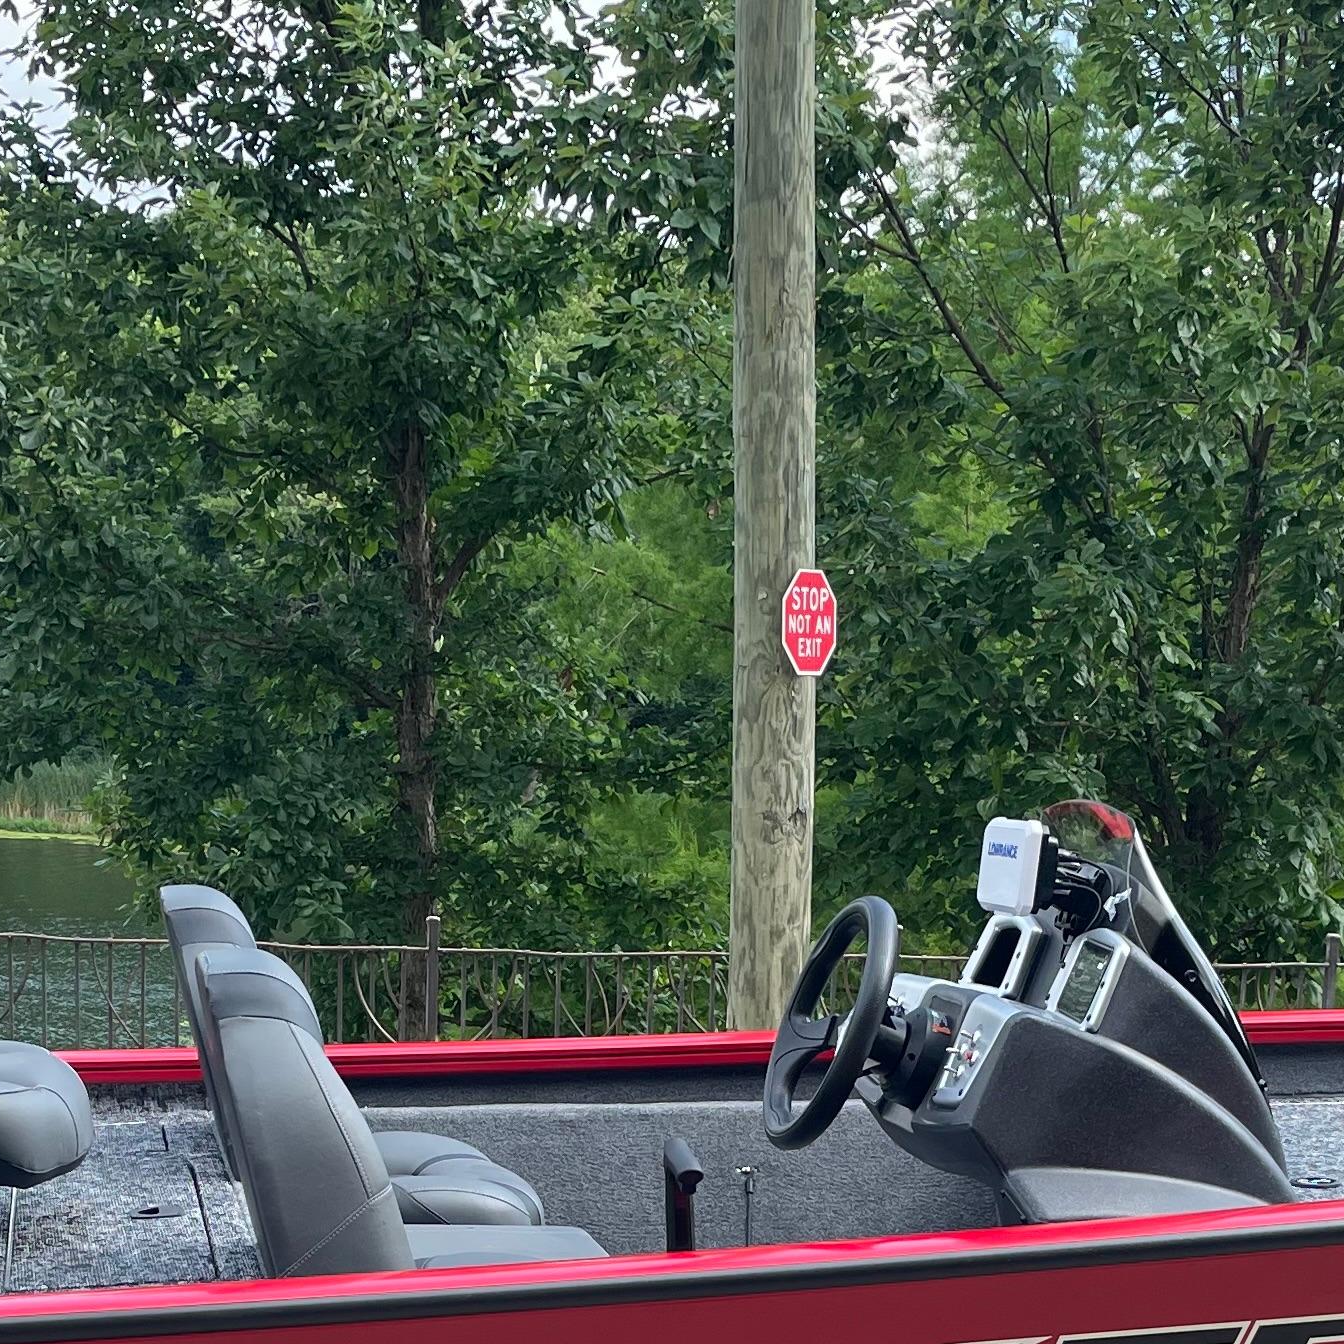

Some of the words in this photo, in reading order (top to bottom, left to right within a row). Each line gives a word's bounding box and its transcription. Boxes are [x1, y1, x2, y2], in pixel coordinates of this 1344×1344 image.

[791, 586, 829, 612] STOP
[788, 614, 811, 634] NOT
[815, 615, 831, 635] AN
[797, 637, 823, 658] EXIT
